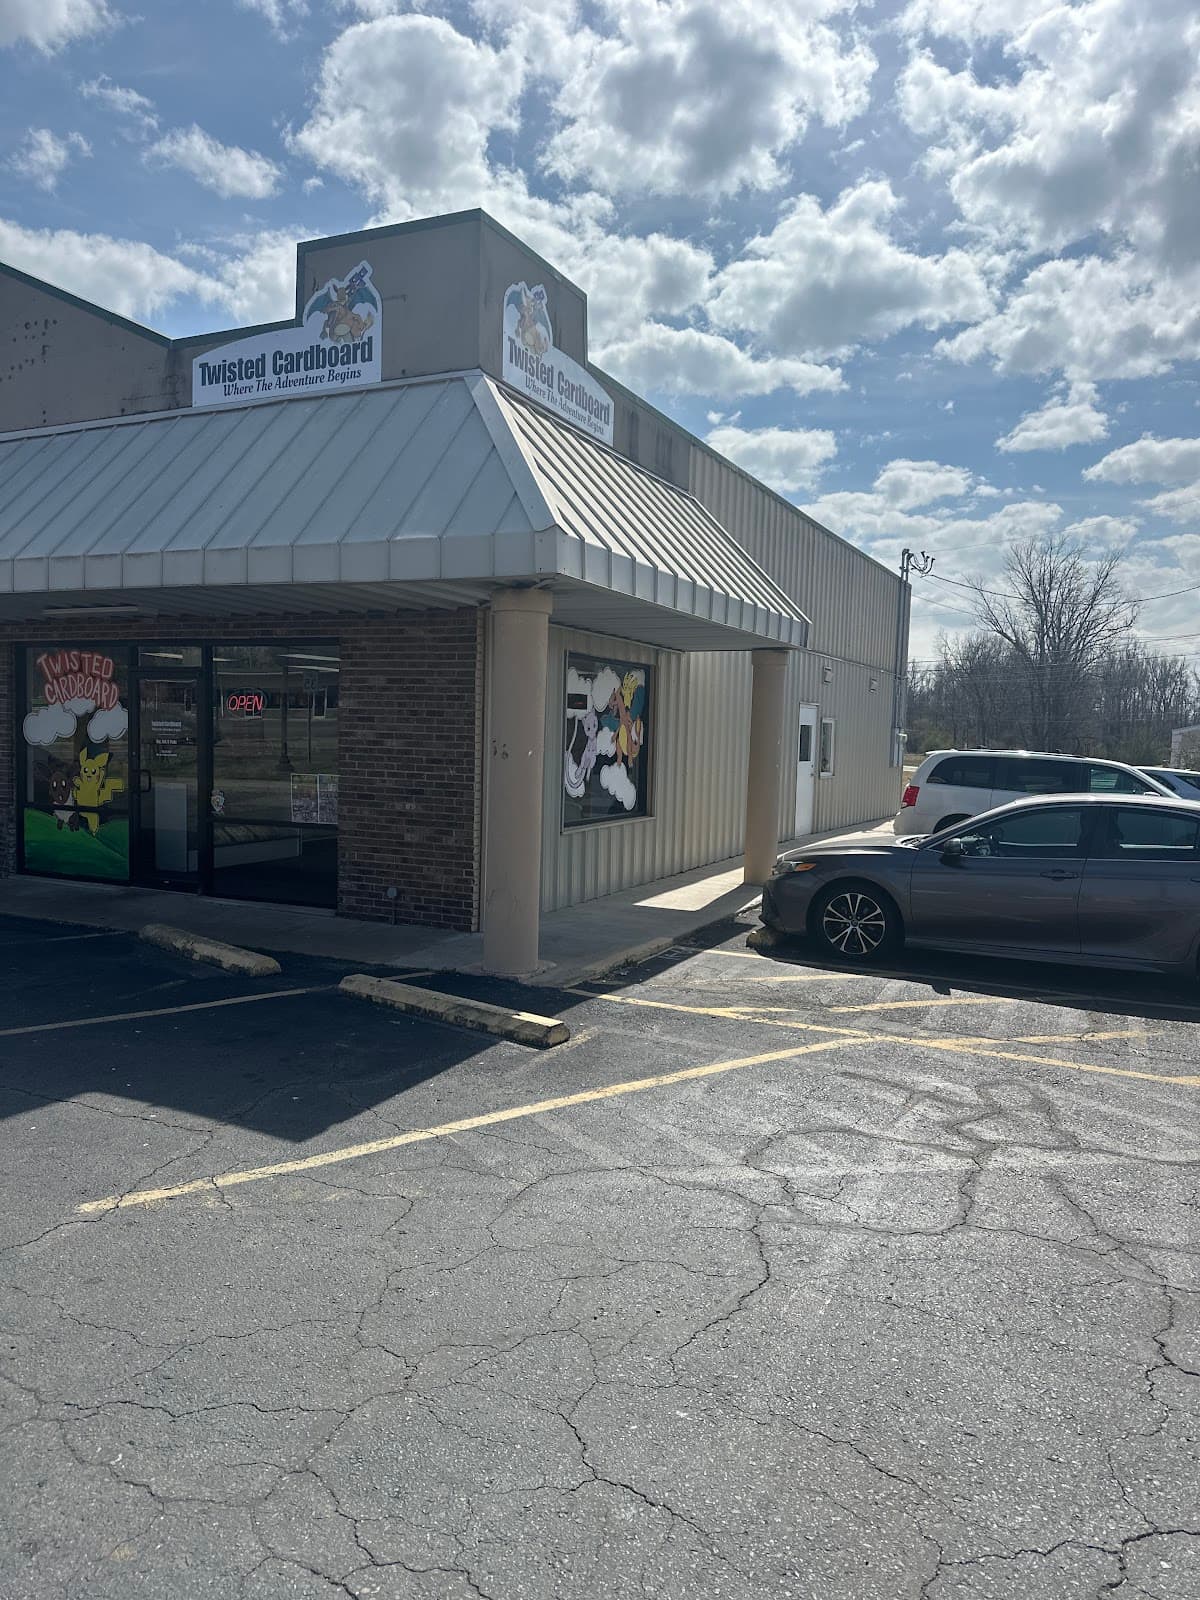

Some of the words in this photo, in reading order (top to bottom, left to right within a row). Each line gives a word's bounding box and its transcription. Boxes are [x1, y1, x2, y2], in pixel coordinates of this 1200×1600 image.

[199, 353, 266, 386] Twisted
[272, 336, 373, 376] Cardboard
[223, 382, 253, 397] Where
[255, 378, 273, 393] The
[274, 373, 326, 390] Adventure
[327, 367, 362, 384] Begins
[507, 335, 554, 389] Twisted
[557, 370, 610, 427] Cardboard
[525, 375, 546, 397] Where
[546, 388, 558, 403] The
[559, 396, 587, 425] Adventure
[36, 651, 113, 682] TWISTED
[44, 674, 119, 709] CARDBOARD
[229, 695, 264, 711] OPEN
